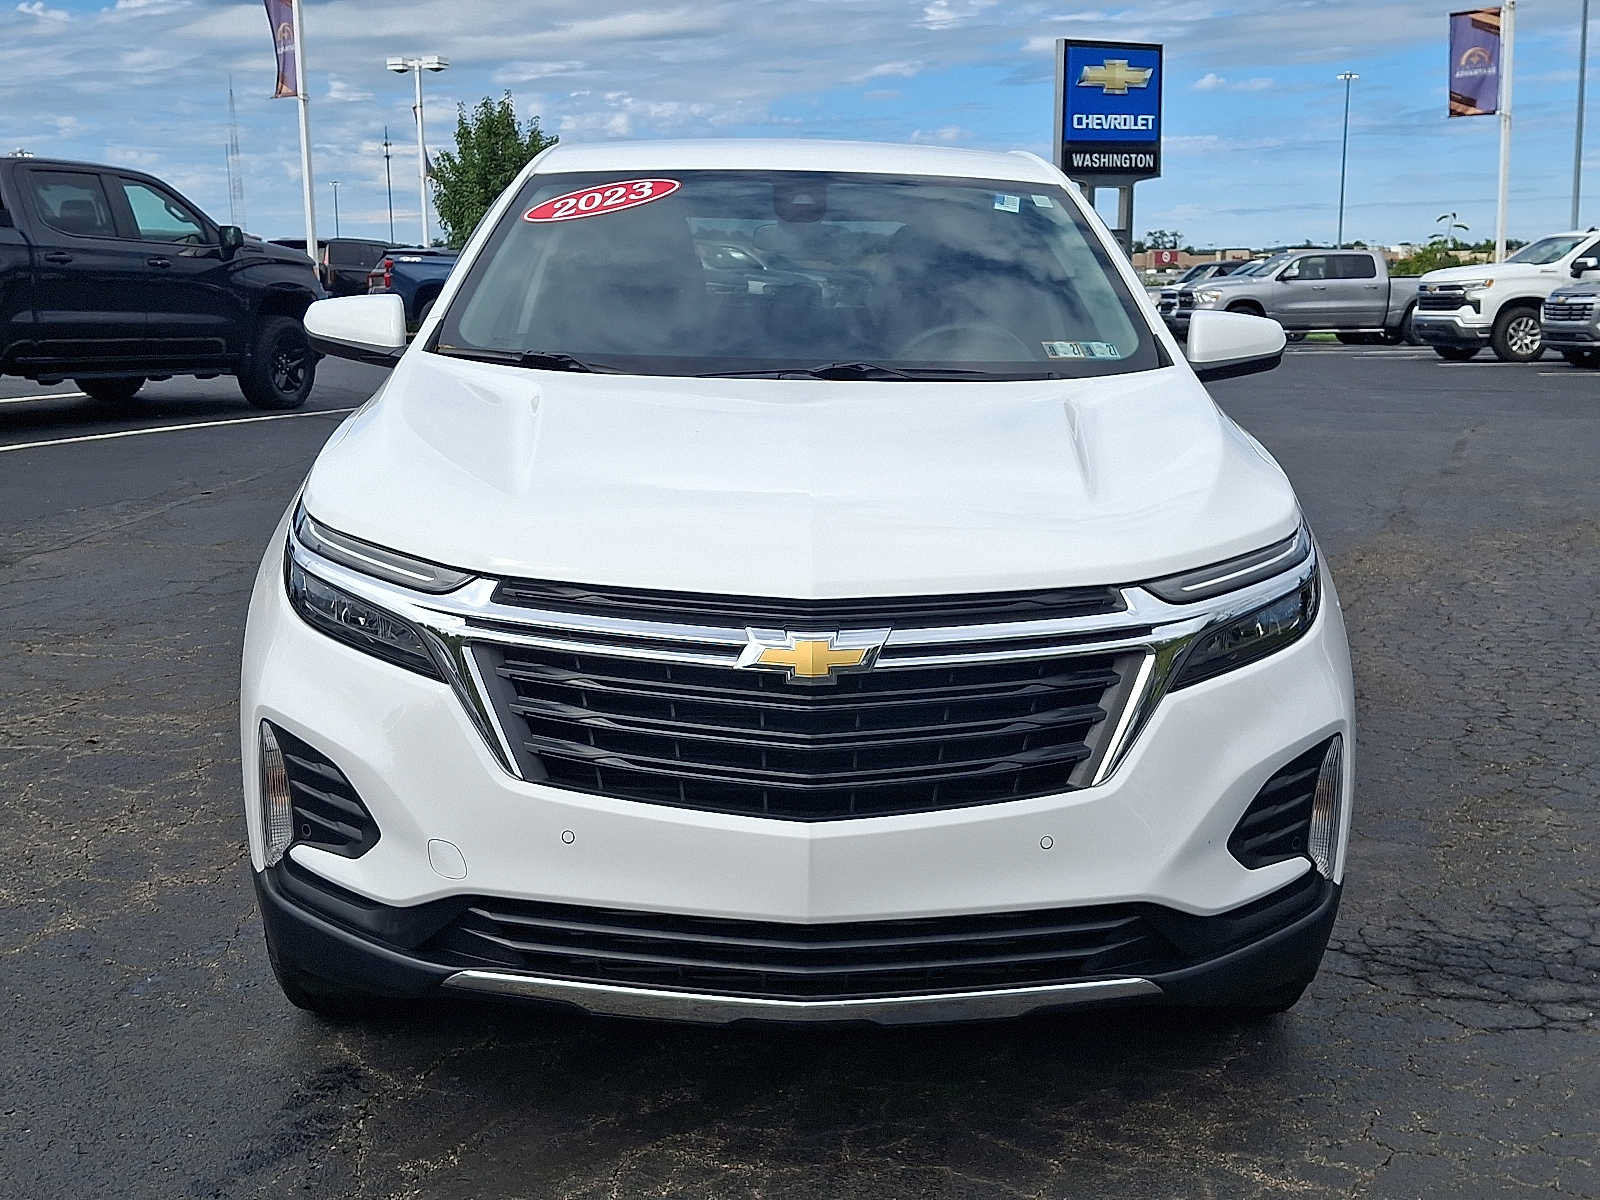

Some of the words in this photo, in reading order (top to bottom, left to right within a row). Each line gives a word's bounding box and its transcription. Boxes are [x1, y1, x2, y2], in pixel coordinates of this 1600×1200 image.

[1072, 114, 1155, 130] CHEVROLET
[1072, 153, 1154, 168] WASHINGTON
[551, 181, 654, 218] 2023
